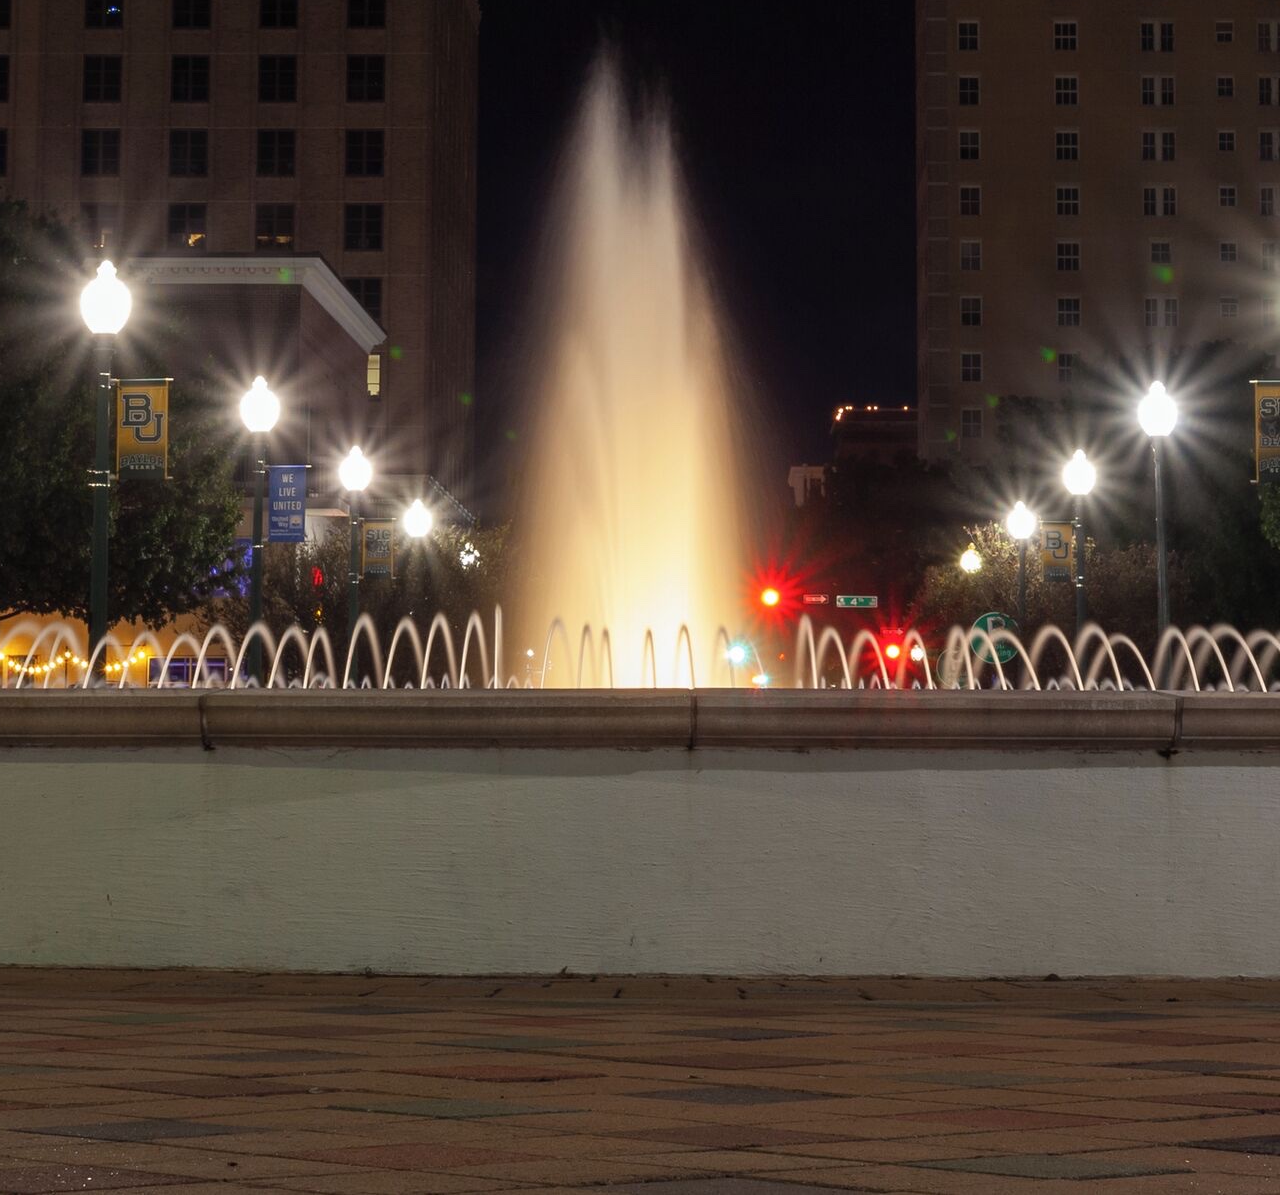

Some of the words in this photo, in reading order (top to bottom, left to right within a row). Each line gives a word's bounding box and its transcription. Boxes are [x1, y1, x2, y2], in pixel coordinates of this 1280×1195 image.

[121, 393, 164, 444] BU
[120, 453, 164, 469] BAYLOR
[282, 473, 294, 483] WE
[279, 487, 297, 497] LIVE
[273, 501, 302, 511] UNITED
[1045, 531, 1069, 559] BU
